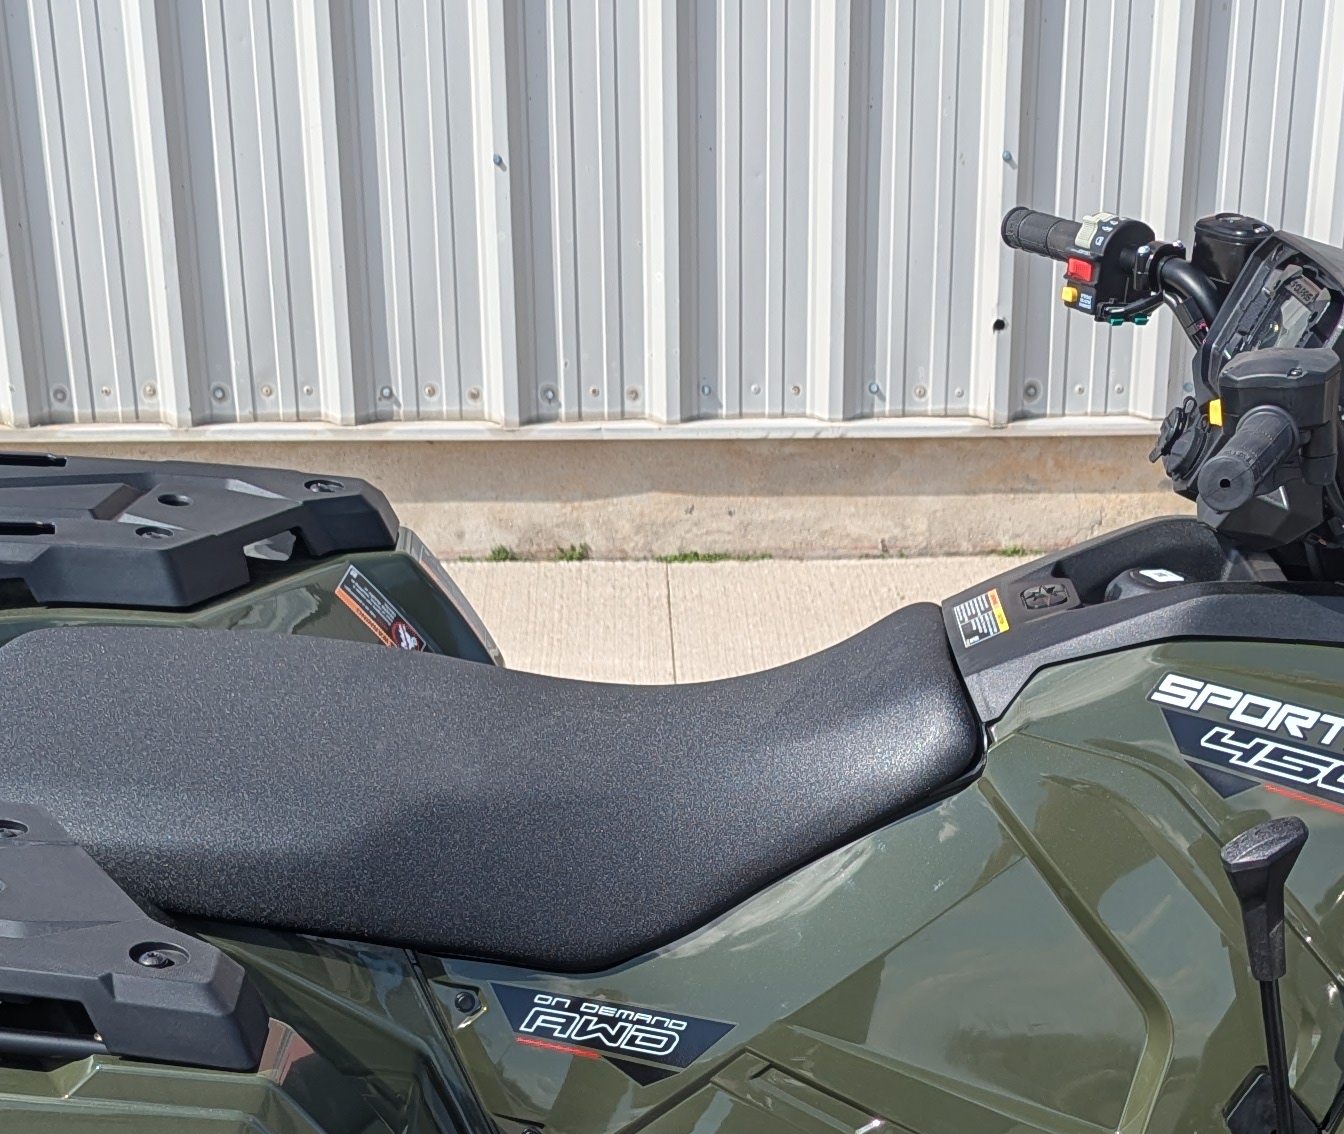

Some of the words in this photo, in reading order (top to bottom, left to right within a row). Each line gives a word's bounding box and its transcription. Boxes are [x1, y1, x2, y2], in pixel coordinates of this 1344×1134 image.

[519, 1007, 679, 1056] AWD
[533, 994, 571, 1008] ON
[580, 1002, 687, 1031] DEMAND
